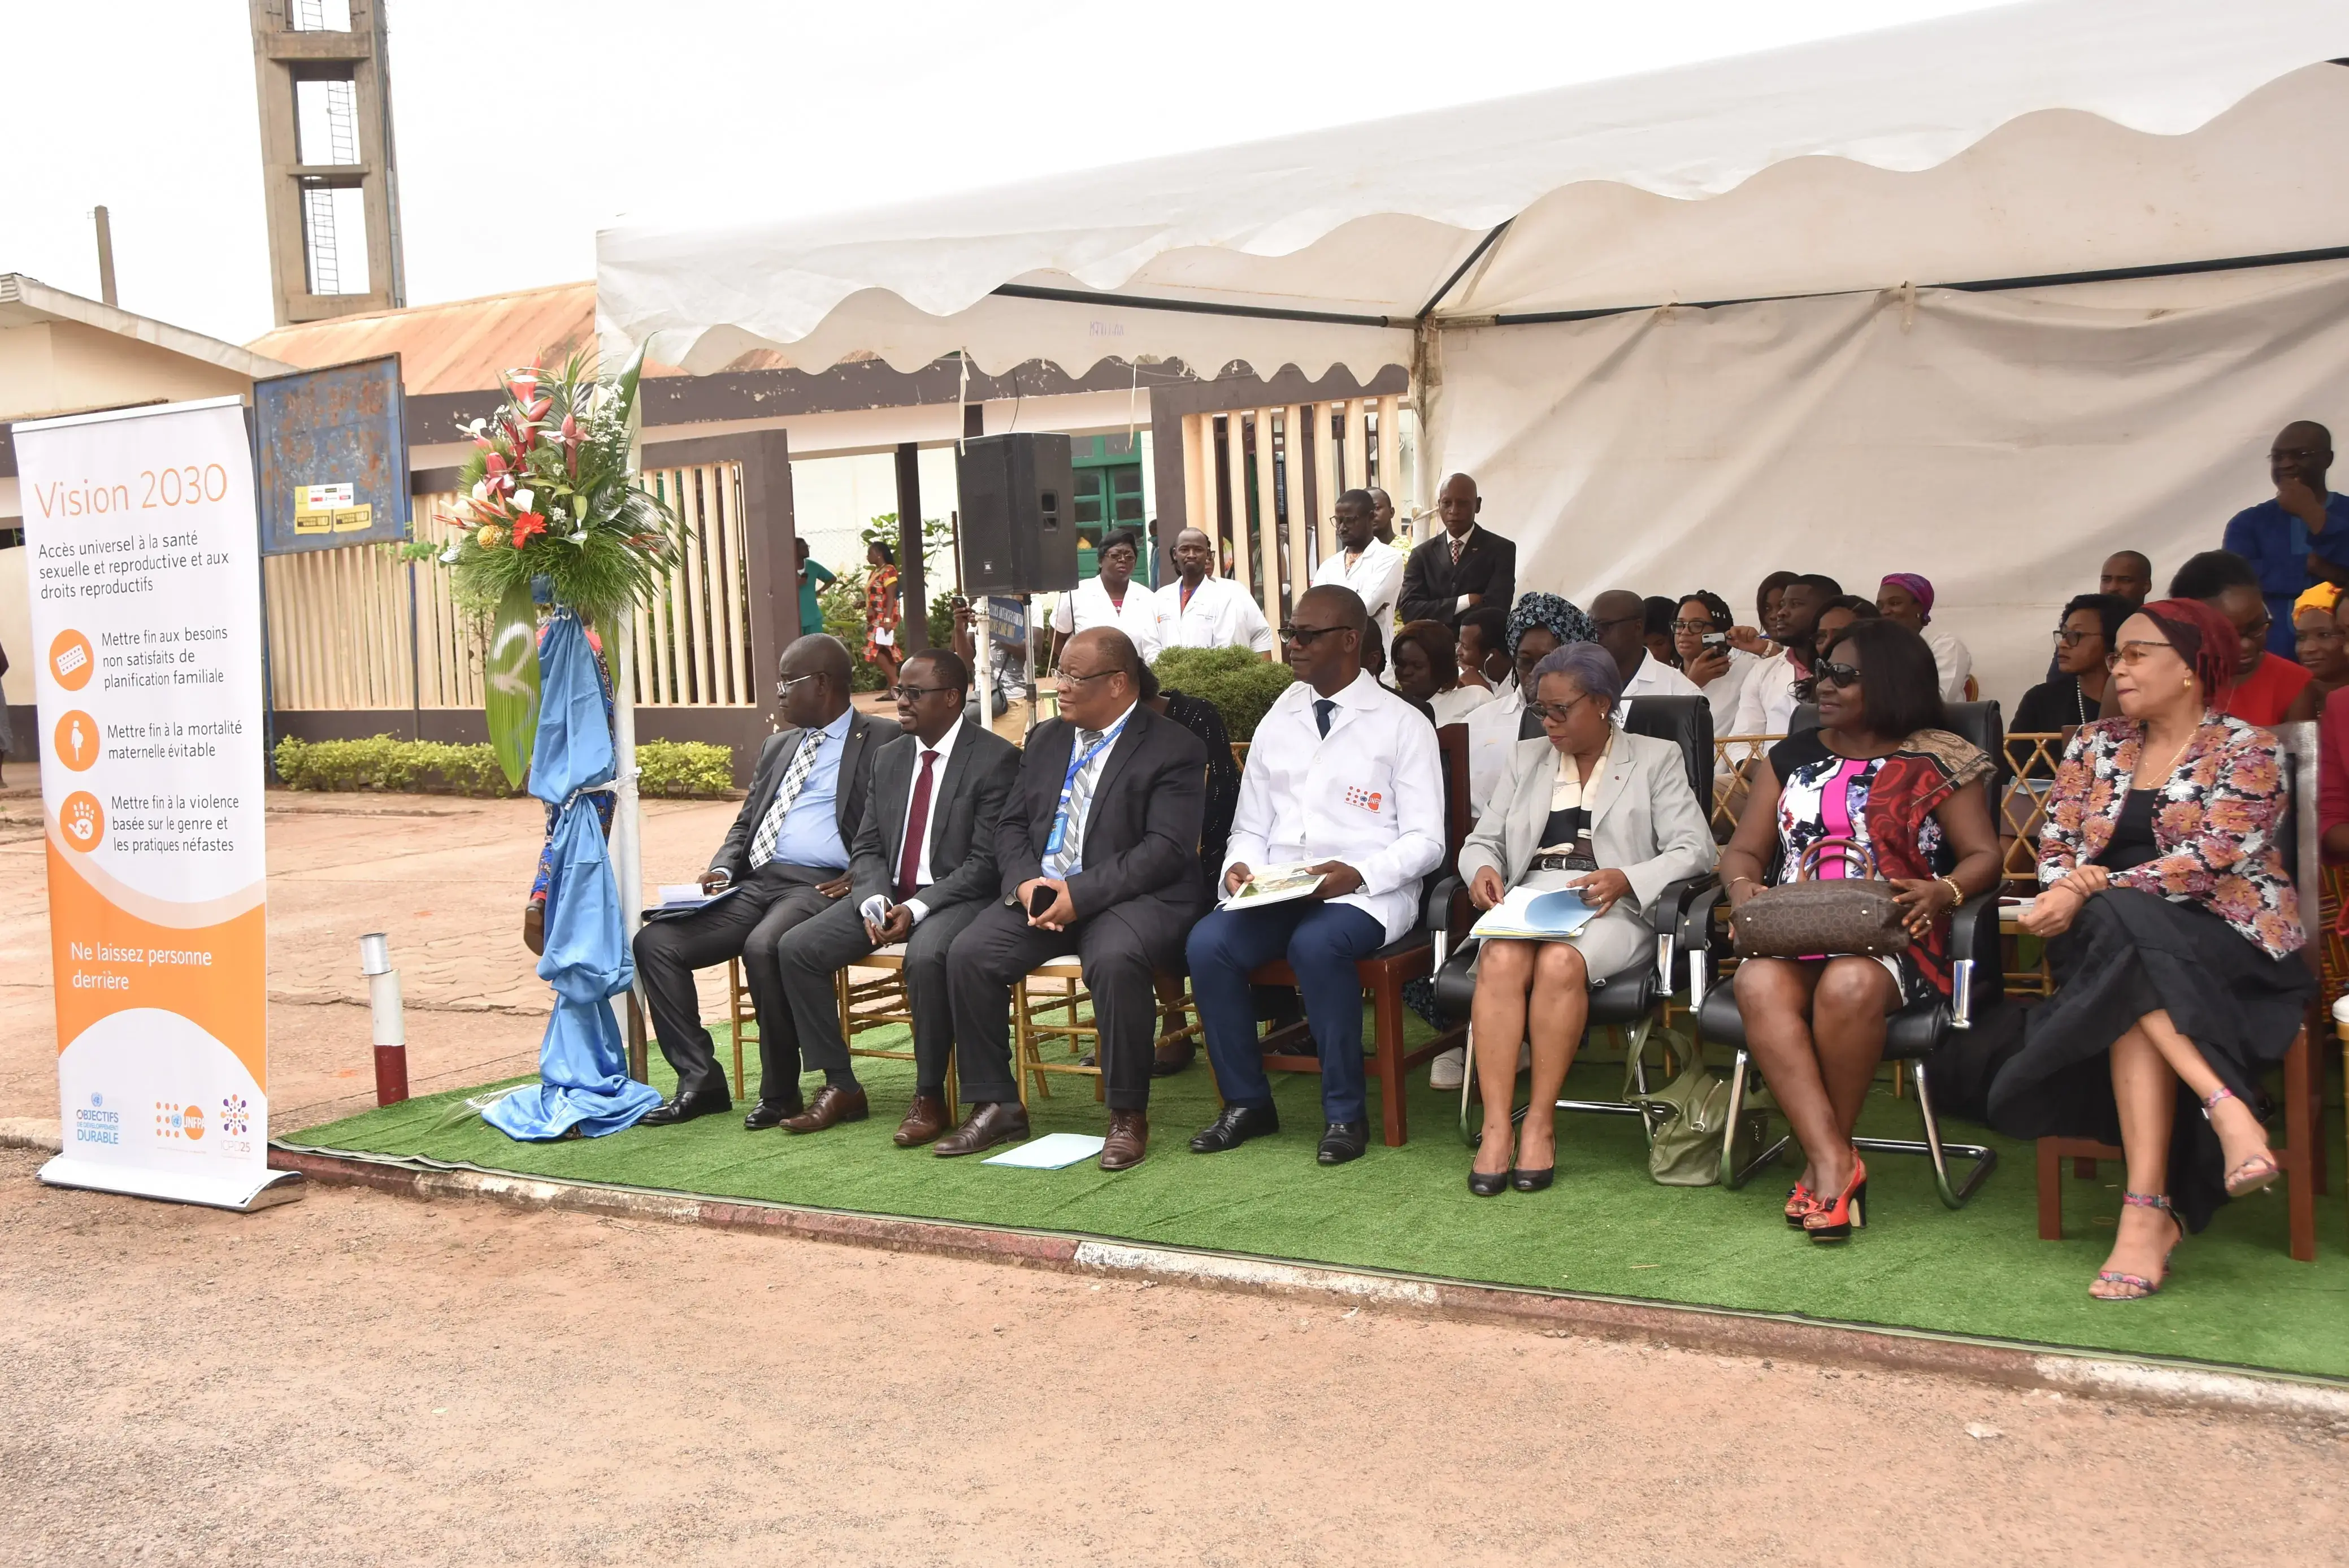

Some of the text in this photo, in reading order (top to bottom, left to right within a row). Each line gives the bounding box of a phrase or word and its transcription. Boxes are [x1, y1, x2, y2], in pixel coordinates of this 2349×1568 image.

[34, 463, 227, 519] Vision 2030
[38, 529, 198, 559] Accès universel à la santé
[40, 551, 229, 579] sexuelle et reproductive et aux
[41, 576, 153, 600] droits reproductifs
[102, 626, 228, 646] Mettre fin aux besoins
[103, 648, 195, 667] non satisfaits de
[104, 668, 224, 692] planification familiale
[107, 719, 242, 739] Mettre fin à la mortalité
[108, 741, 215, 759] maternelle évitable
[111, 793, 239, 810] Mettre fin à la violence
[112, 815, 228, 833] basée sur le genre et
[114, 836, 234, 854] les pratiques néfastes
[71, 942, 212, 967] Ne laissez personne
[72, 969, 129, 990] derrière
[76, 1109, 119, 1123] OBJECTIFS
[183, 1115, 205, 1130] UNFPA
[77, 1129, 119, 1145] DURABLE
